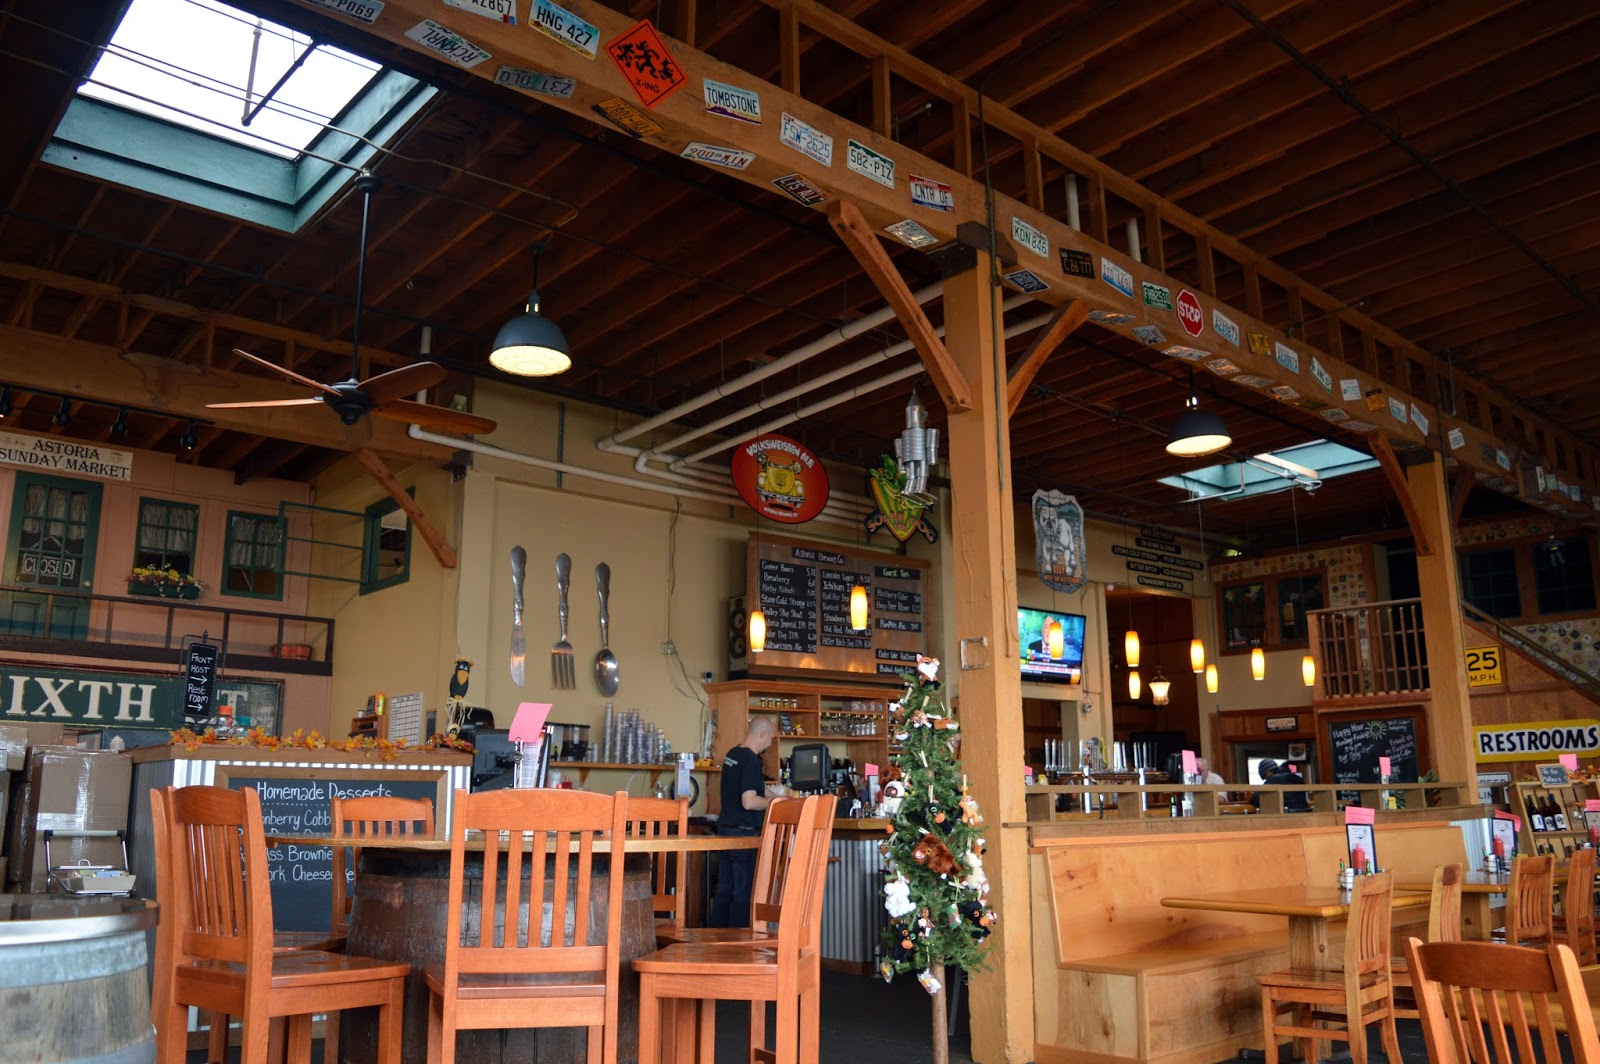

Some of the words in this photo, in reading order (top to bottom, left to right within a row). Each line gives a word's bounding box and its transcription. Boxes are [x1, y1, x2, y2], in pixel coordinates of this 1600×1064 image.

[537, 6, 564, 31] HNG
[567, 24, 593, 46] 427
[636, 78, 660, 93] X-ING
[706, 88, 759, 115] TOMBSTONE
[1179, 300, 1201, 324] STOP
[33, 440, 100, 460] ASTORIA
[0, 447, 64, 467] SUNDAY
[65, 458, 129, 478] MARKET
[800, 452, 815, 469] ALE
[190, 664, 210, 674] HOST
[1467, 651, 1497, 671] 25
[0, 675, 157, 723] IXTH
[188, 683, 206, 695] Rest
[189, 694, 209, 704] room
[1332, 728, 1351, 739] Happy
[1351, 723, 1365, 732] Hour
[1480, 727, 1598, 753] RESTROOMS
[257, 781, 324, 801] Homemade
[329, 782, 392, 799] Desserts
[262, 810, 300, 830] nberry
[304, 810, 331, 826] Cobb
[268, 864, 285, 882] ork
